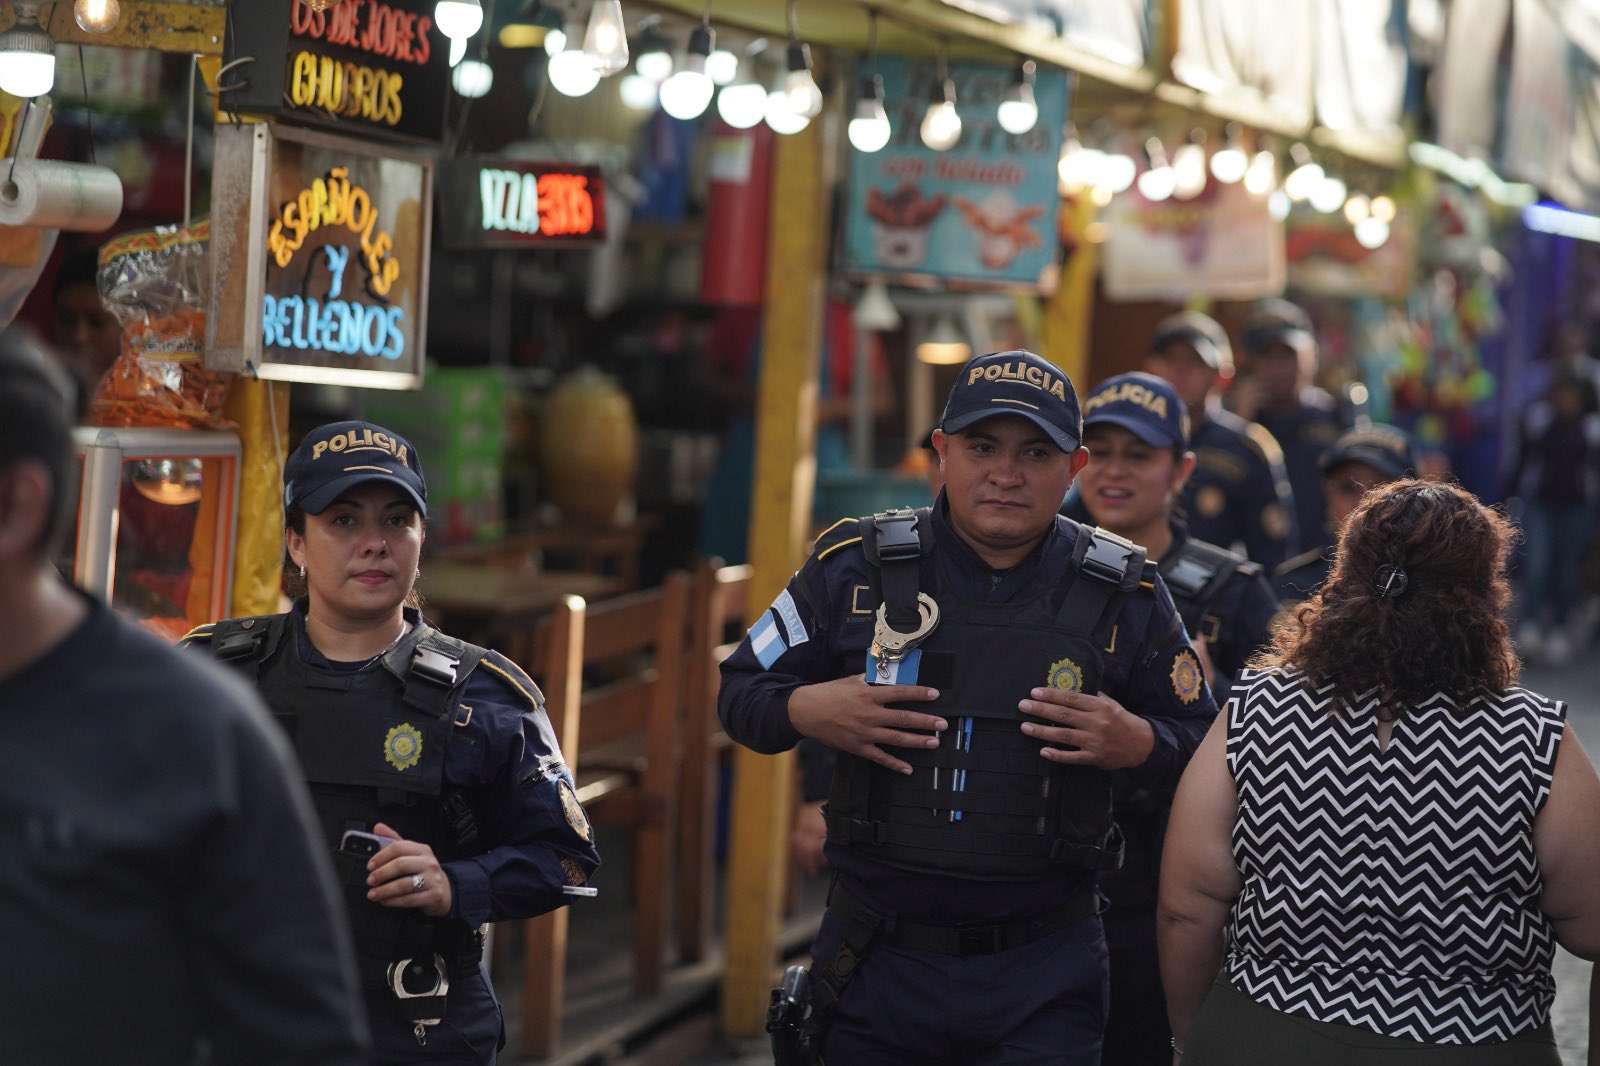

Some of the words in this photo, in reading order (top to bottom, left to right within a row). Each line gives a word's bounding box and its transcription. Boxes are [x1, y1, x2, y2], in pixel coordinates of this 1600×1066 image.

[292, 51, 402, 125] CHURROS
[268, 167, 400, 295] ESPAÑOLES
[324, 244, 350, 299] Y
[263, 294, 405, 360] RELLENOS
[967, 361, 1066, 402] POLICIA
[312, 428, 409, 469] POLICIA
